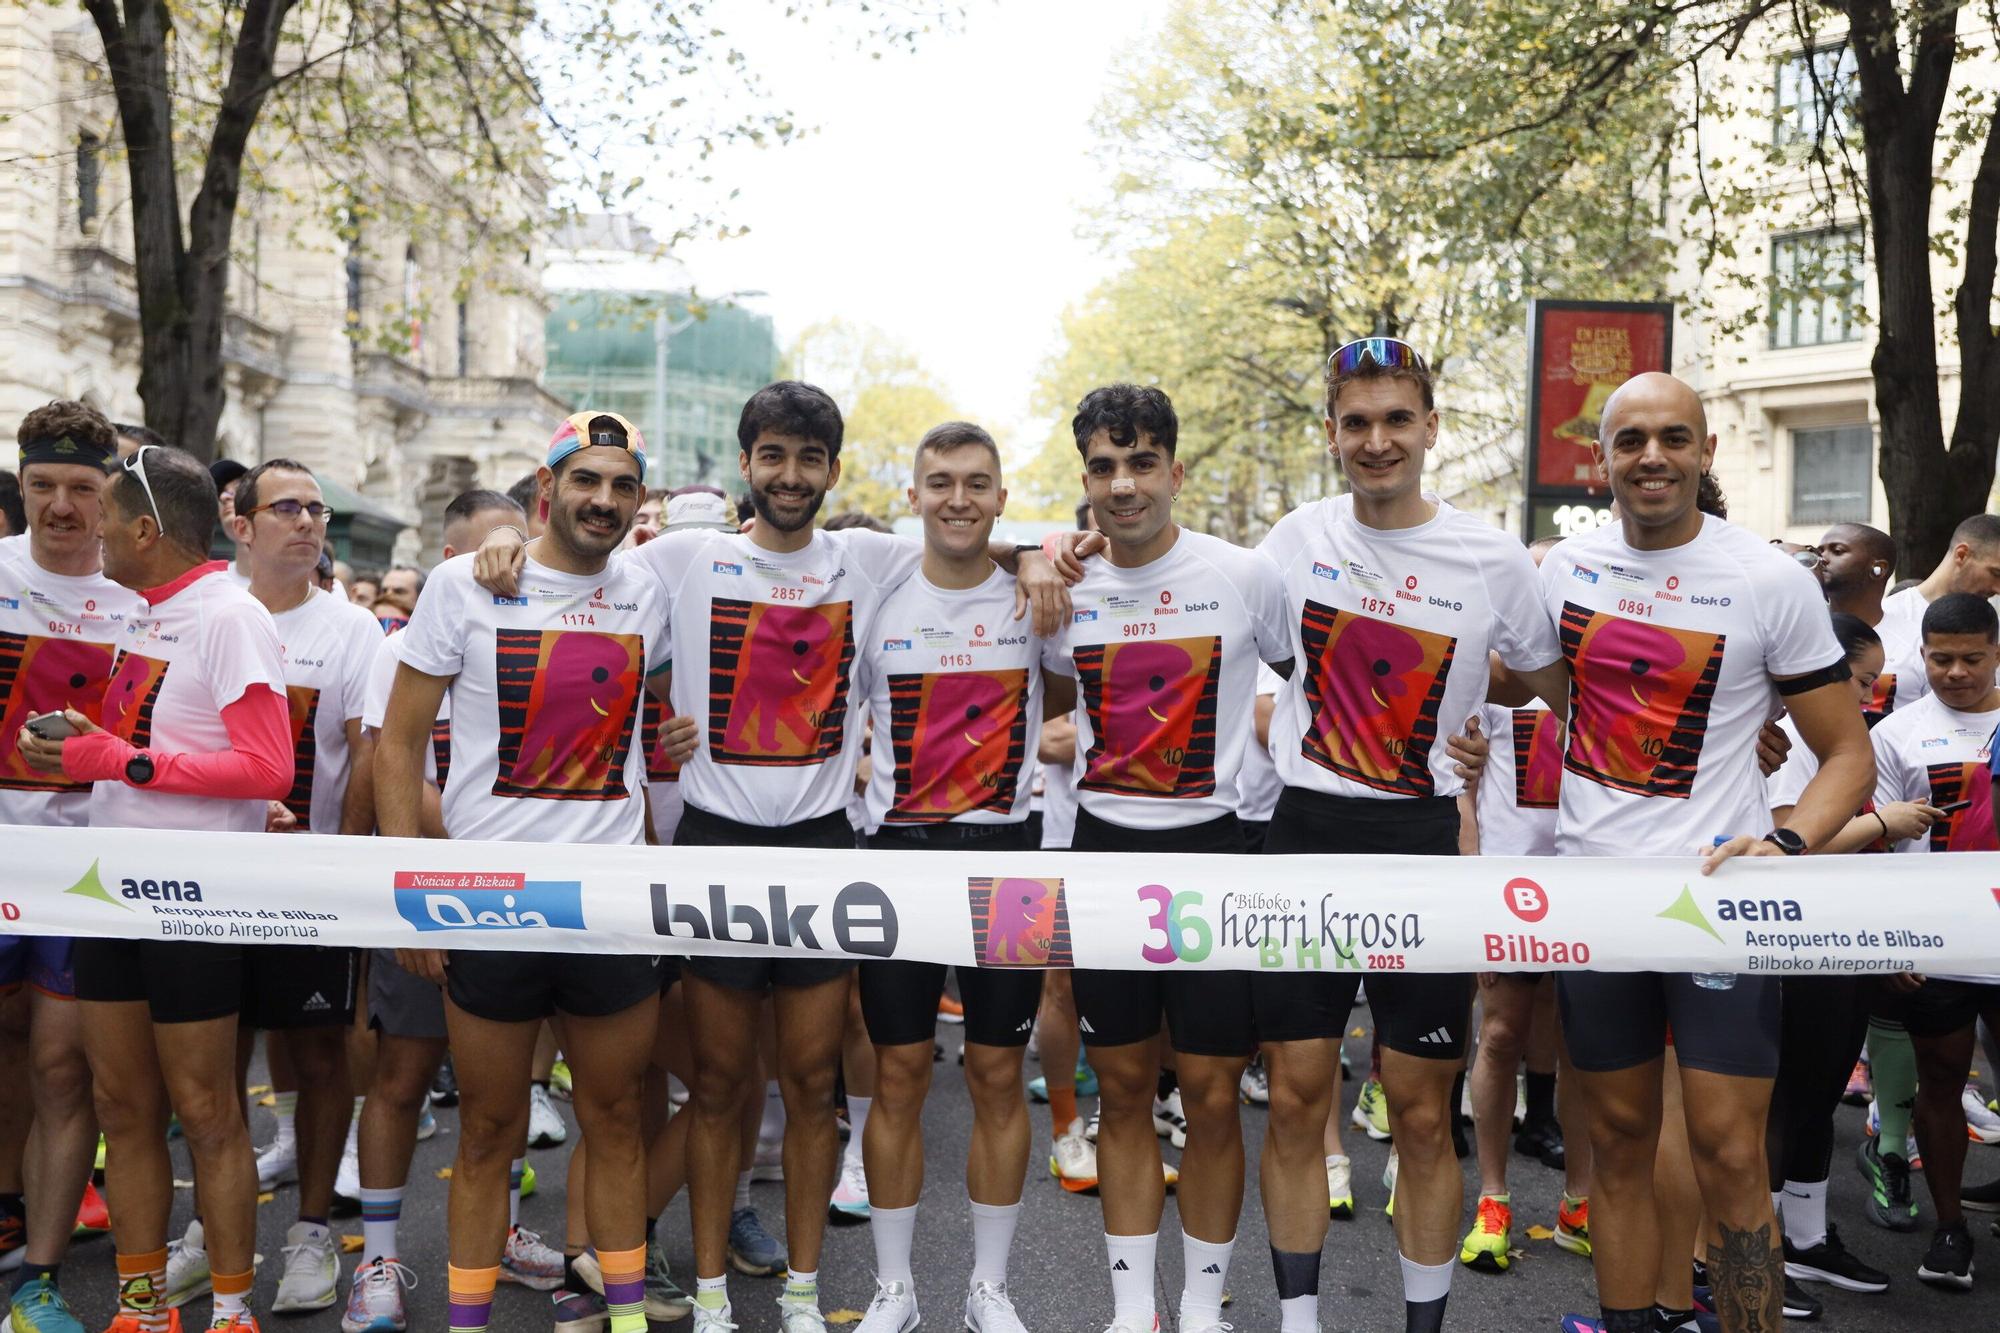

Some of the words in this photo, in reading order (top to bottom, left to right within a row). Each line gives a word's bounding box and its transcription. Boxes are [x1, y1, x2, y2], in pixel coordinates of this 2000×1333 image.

[1315, 565, 1334, 579] Deia
[1576, 569, 1594, 583] Deia
[771, 586, 805, 601] 2857
[1395, 590, 1422, 603] Bilbao
[1654, 590, 1683, 603] Bilbao
[1154, 607, 1179, 616] Bilbao
[1185, 603, 1209, 613] bbk
[1361, 596, 1396, 617] 1875
[1617, 598, 1654, 618] 0891
[49, 620, 82, 636] 0574
[561, 613, 596, 627] 1174
[1123, 622, 1157, 637] 9073
[969, 639, 992, 648] Bilbao
[998, 637, 1018, 646] bbk
[940, 654, 973, 667] 0163
[1641, 736, 1664, 756] 10
[1164, 746, 1185, 765] 10
[411, 874, 456, 888] Noticias
[458, 875, 471, 888] de
[472, 875, 517, 888] Bizkaia
[121, 878, 203, 903] aena
[1234, 892, 1292, 913] Bilboko
[1512, 887, 1542, 912] B
[152, 905, 251, 920] Aeropuerto
[257, 909, 277, 920] de
[281, 910, 338, 922] Bilbao
[649, 883, 825, 951] bbk
[1717, 898, 1803, 922] aena
[161, 919, 225, 937] Bilboko
[229, 923, 319, 941] Aireportua
[1137, 884, 1213, 964] 36
[1220, 892, 1314, 949] herri
[1319, 892, 1426, 960] krosa
[1745, 929, 1851, 951] Aeropuerto
[1856, 930, 1880, 948] de
[1885, 930, 1944, 949] Bilbao
[1483, 933, 1591, 965] Bilbao
[1367, 954, 1406, 970] 2025
[1748, 955, 1814, 971] Bilboko
[1818, 957, 1915, 973] Aireportua
